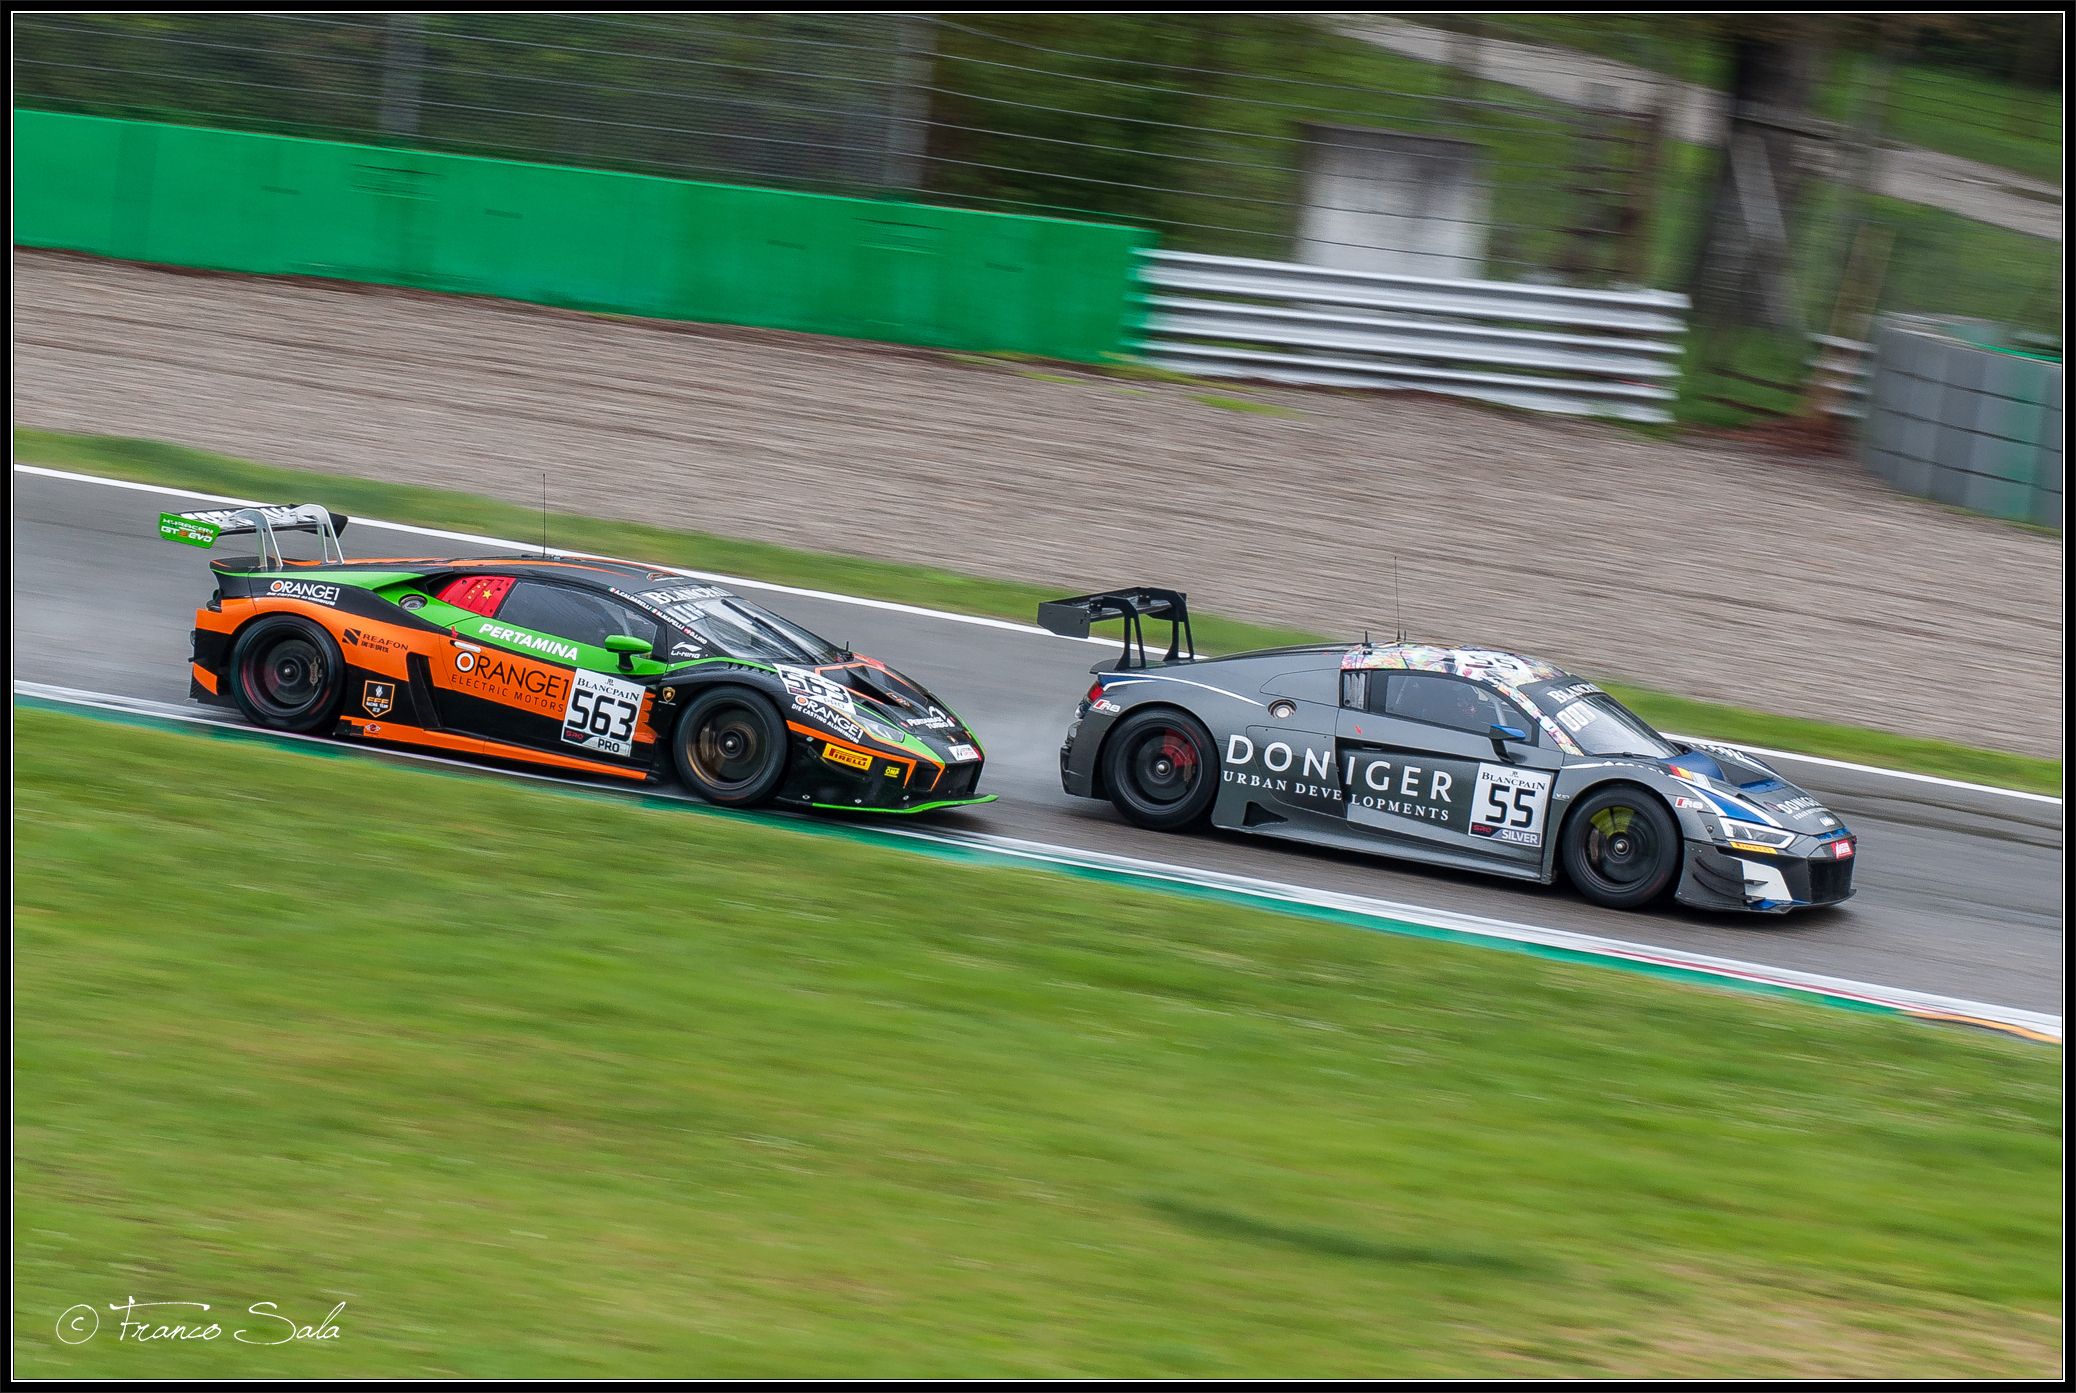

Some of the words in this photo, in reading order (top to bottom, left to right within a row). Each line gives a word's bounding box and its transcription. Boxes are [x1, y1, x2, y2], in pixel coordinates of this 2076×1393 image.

[270, 580, 340, 601] ORANGE1
[363, 634, 409, 651] REAFON
[479, 623, 578, 661] PERTAMINA
[451, 674, 508, 697] ELECTRIC
[513, 691, 565, 713] MOTORS
[455, 651, 570, 701] ORANGE1
[577, 677, 641, 702] BLANCPAIN
[567, 688, 638, 742] 563
[791, 703, 802, 712] DIE
[802, 707, 828, 724] CASTING
[826, 721, 860, 744] ALUMINIUM
[795, 695, 864, 739] ORANGE1
[597, 738, 621, 753] PRO
[828, 747, 868, 767] PIRELLI
[1226, 734, 1452, 803] DONIGER
[1481, 771, 1546, 791] BLANCPAIN
[1223, 770, 1287, 791] URBAN
[1295, 782, 1449, 821] DEVELOPMENTS
[1485, 782, 1536, 828] 55
[1501, 829, 1538, 845] SILVER
